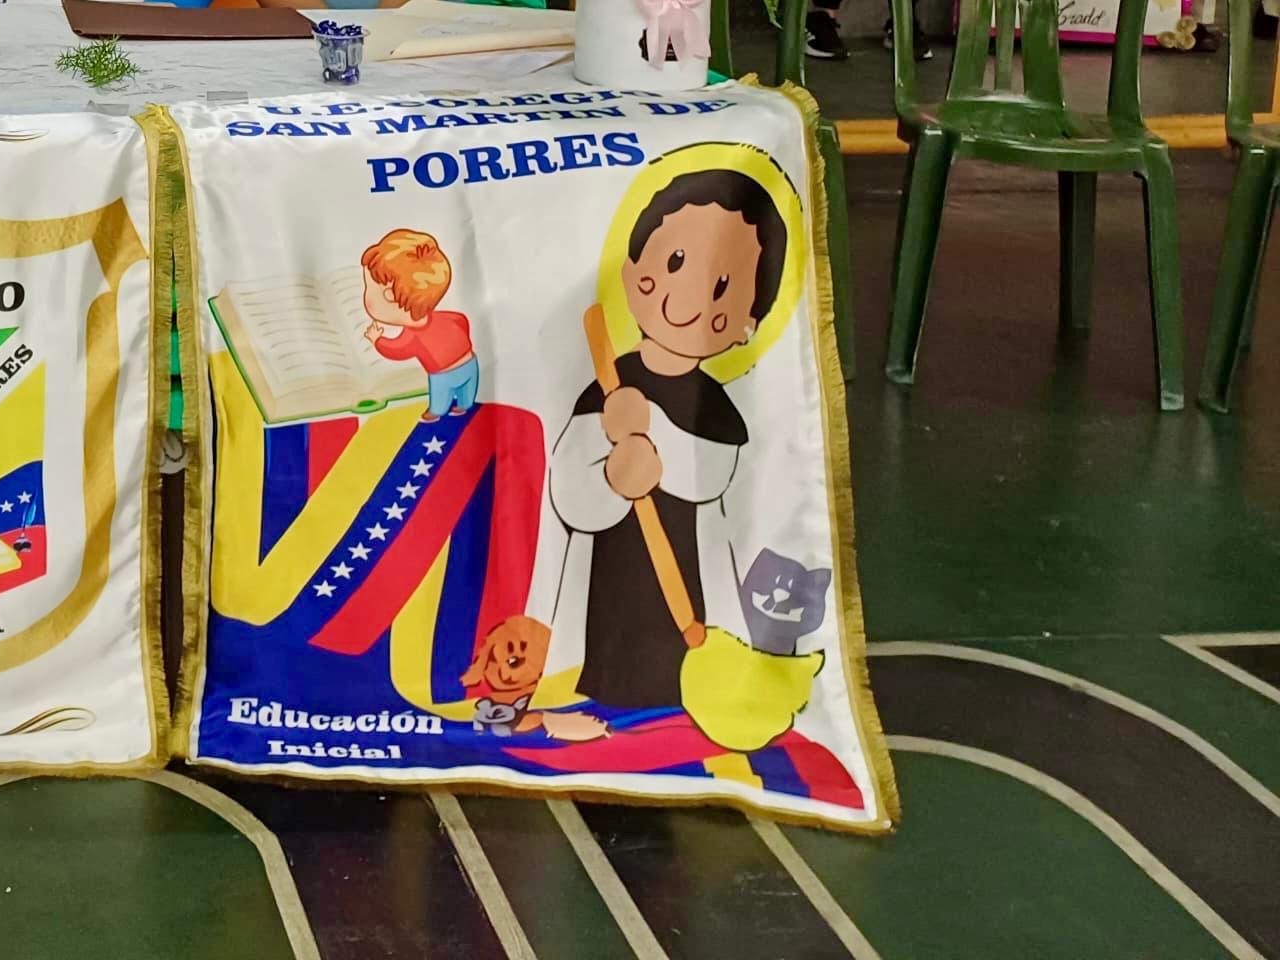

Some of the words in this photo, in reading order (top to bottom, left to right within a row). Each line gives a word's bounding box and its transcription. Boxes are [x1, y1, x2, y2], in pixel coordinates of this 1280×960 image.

[225, 121, 353, 137] SAN
[369, 106, 627, 135] MARTIN
[639, 99, 738, 116] DE
[366, 132, 646, 193] PORRES
[227, 697, 444, 735] Educación
[267, 740, 402, 760] Inicial
